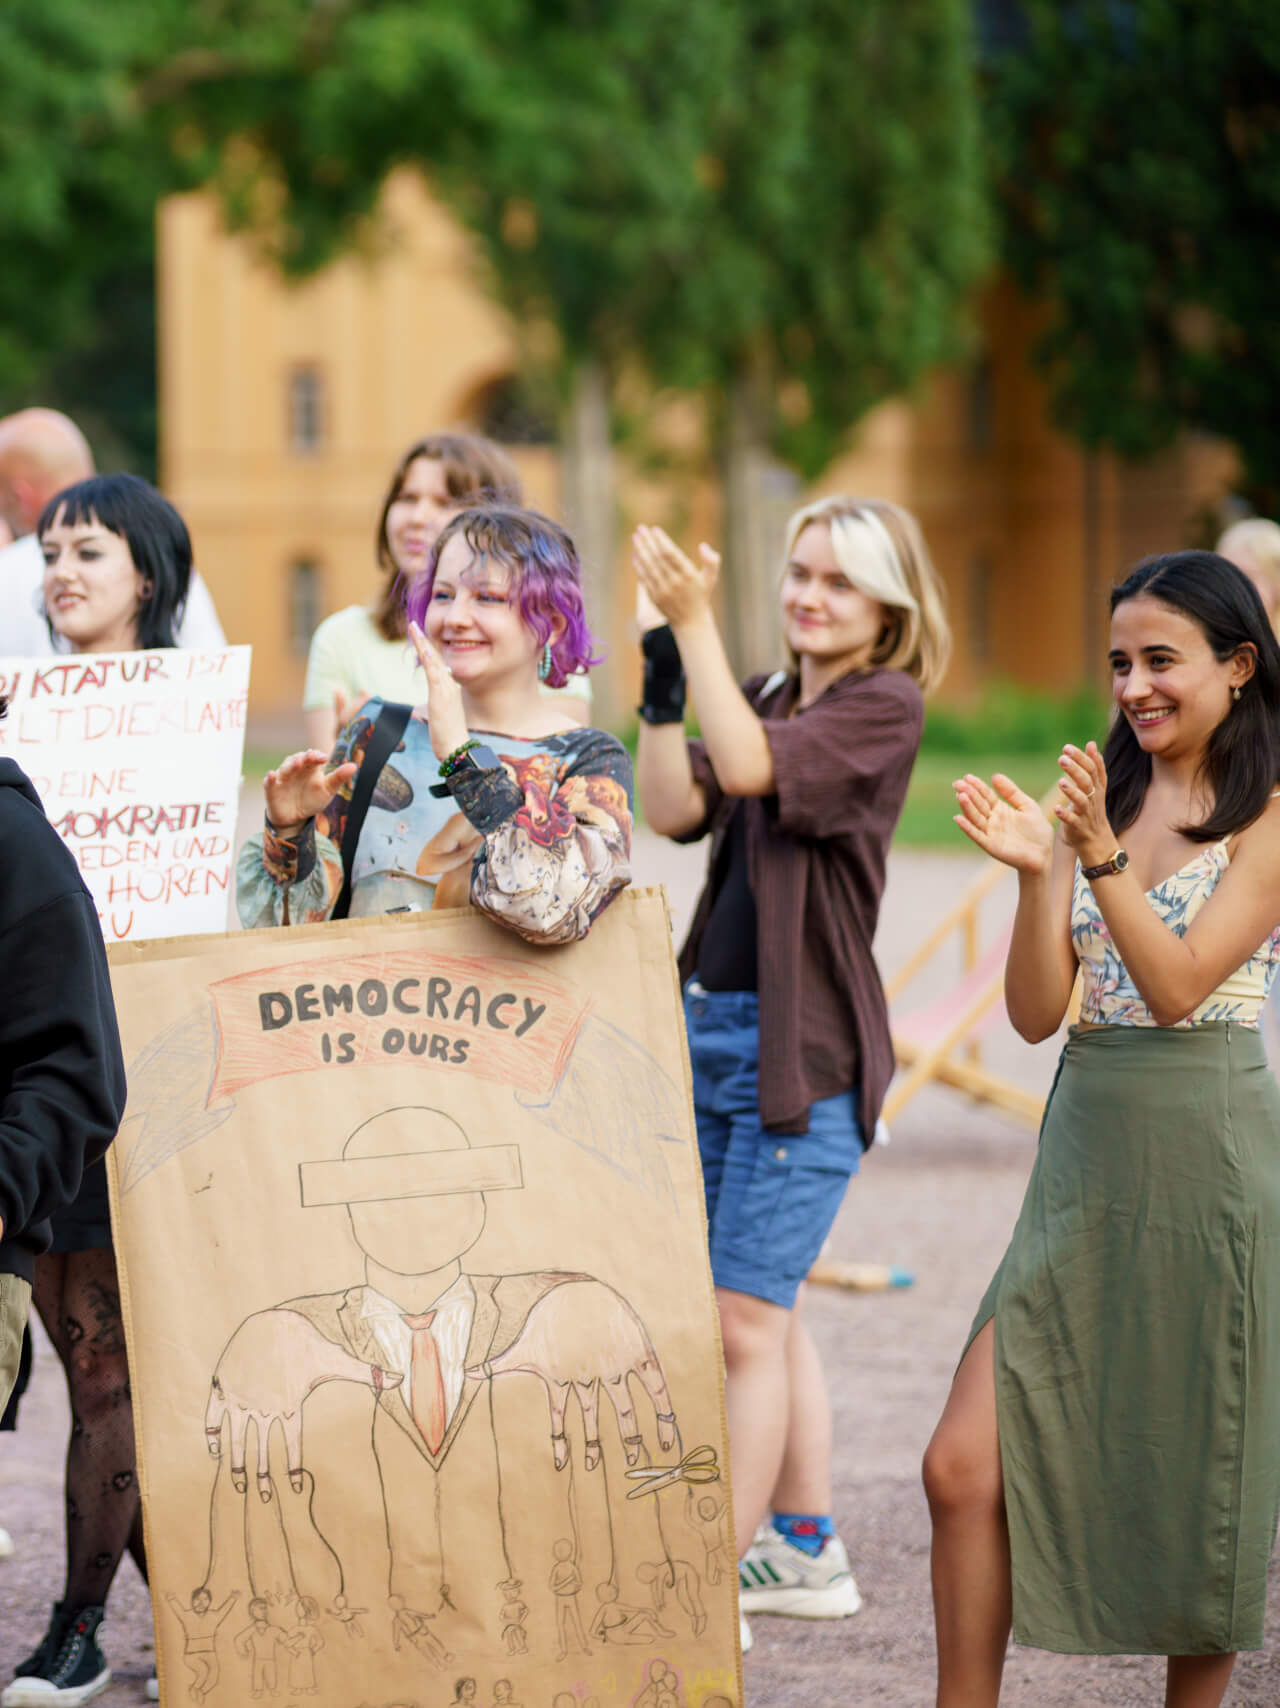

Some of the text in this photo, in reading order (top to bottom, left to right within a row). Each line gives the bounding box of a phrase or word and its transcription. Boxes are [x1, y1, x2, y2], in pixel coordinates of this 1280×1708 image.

[186, 652, 232, 681] IST
[50, 802, 225, 839] MOKRATIE
[78, 835, 230, 871] EDEN UND
[259, 977, 546, 1037] DEMOCRACY
[322, 1028, 470, 1064] IS OURS
